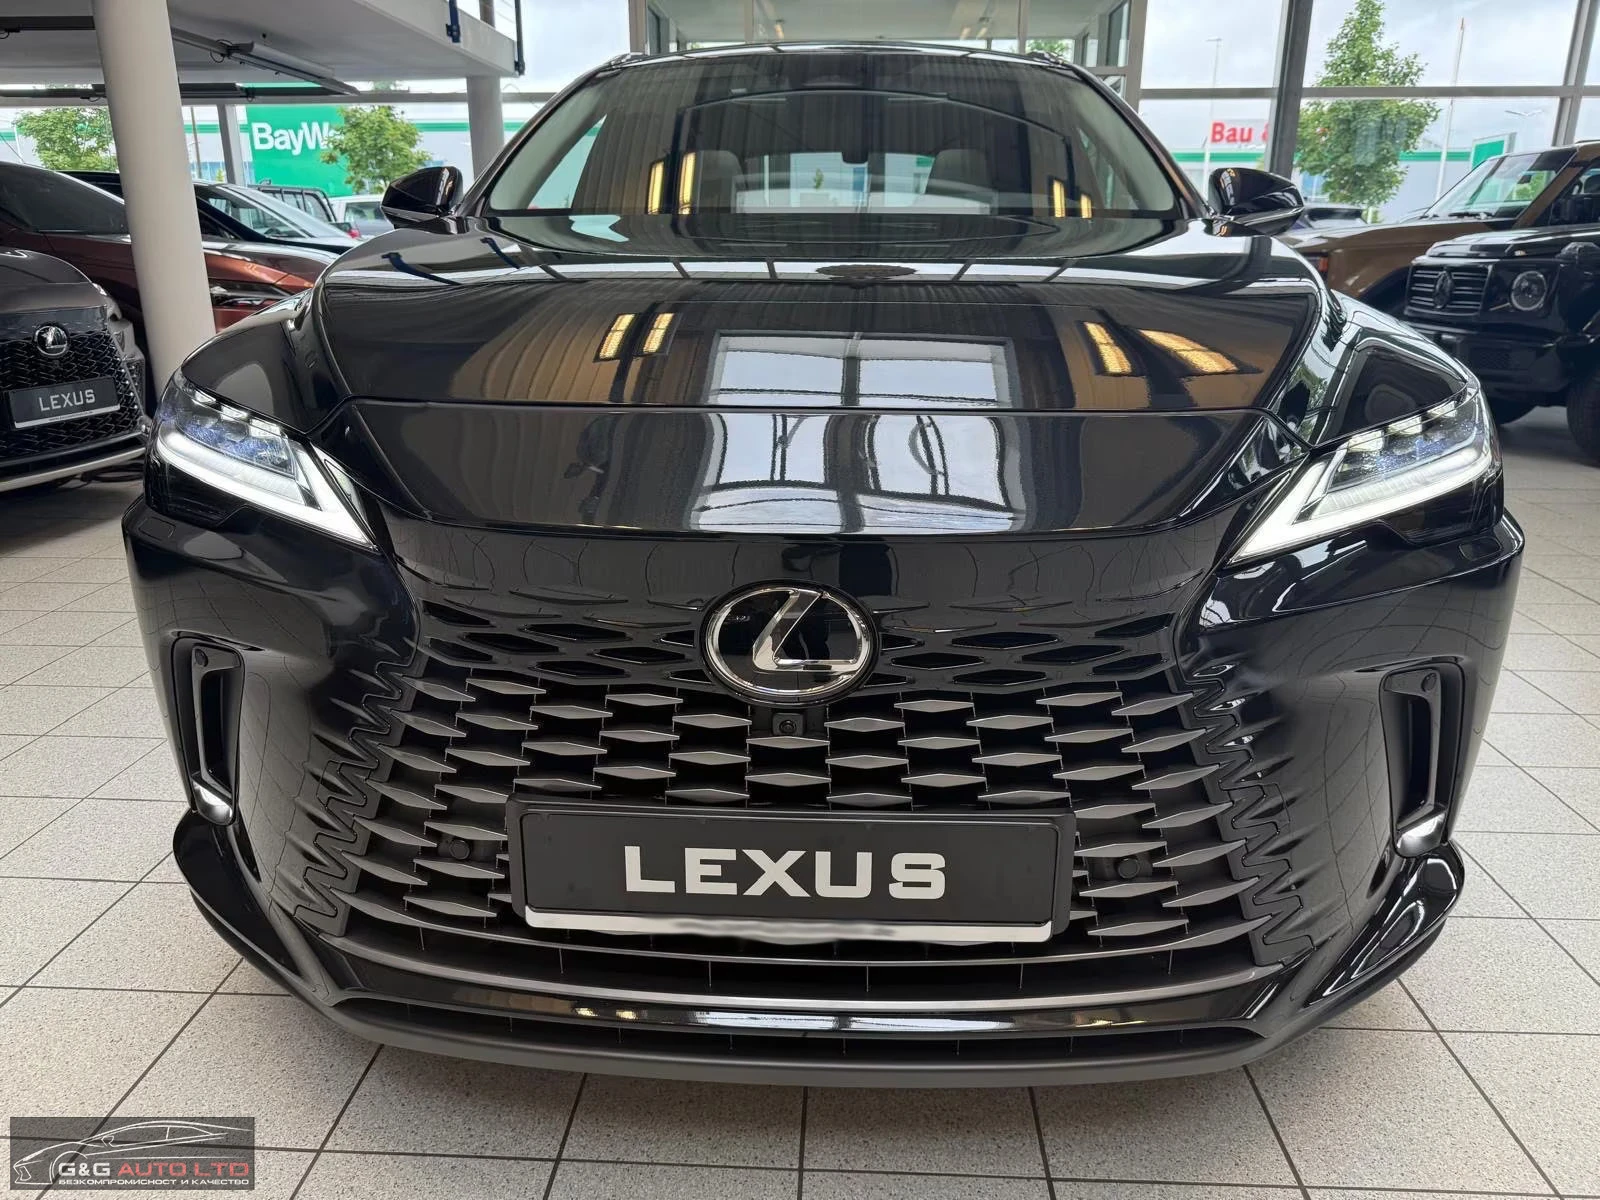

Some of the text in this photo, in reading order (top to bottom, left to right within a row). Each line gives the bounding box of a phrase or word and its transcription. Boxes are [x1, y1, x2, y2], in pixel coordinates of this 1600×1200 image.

[1211, 122, 1252, 143] Bau
[39, 389, 96, 412] LEXUS
[623, 844, 947, 900] LEXUS
